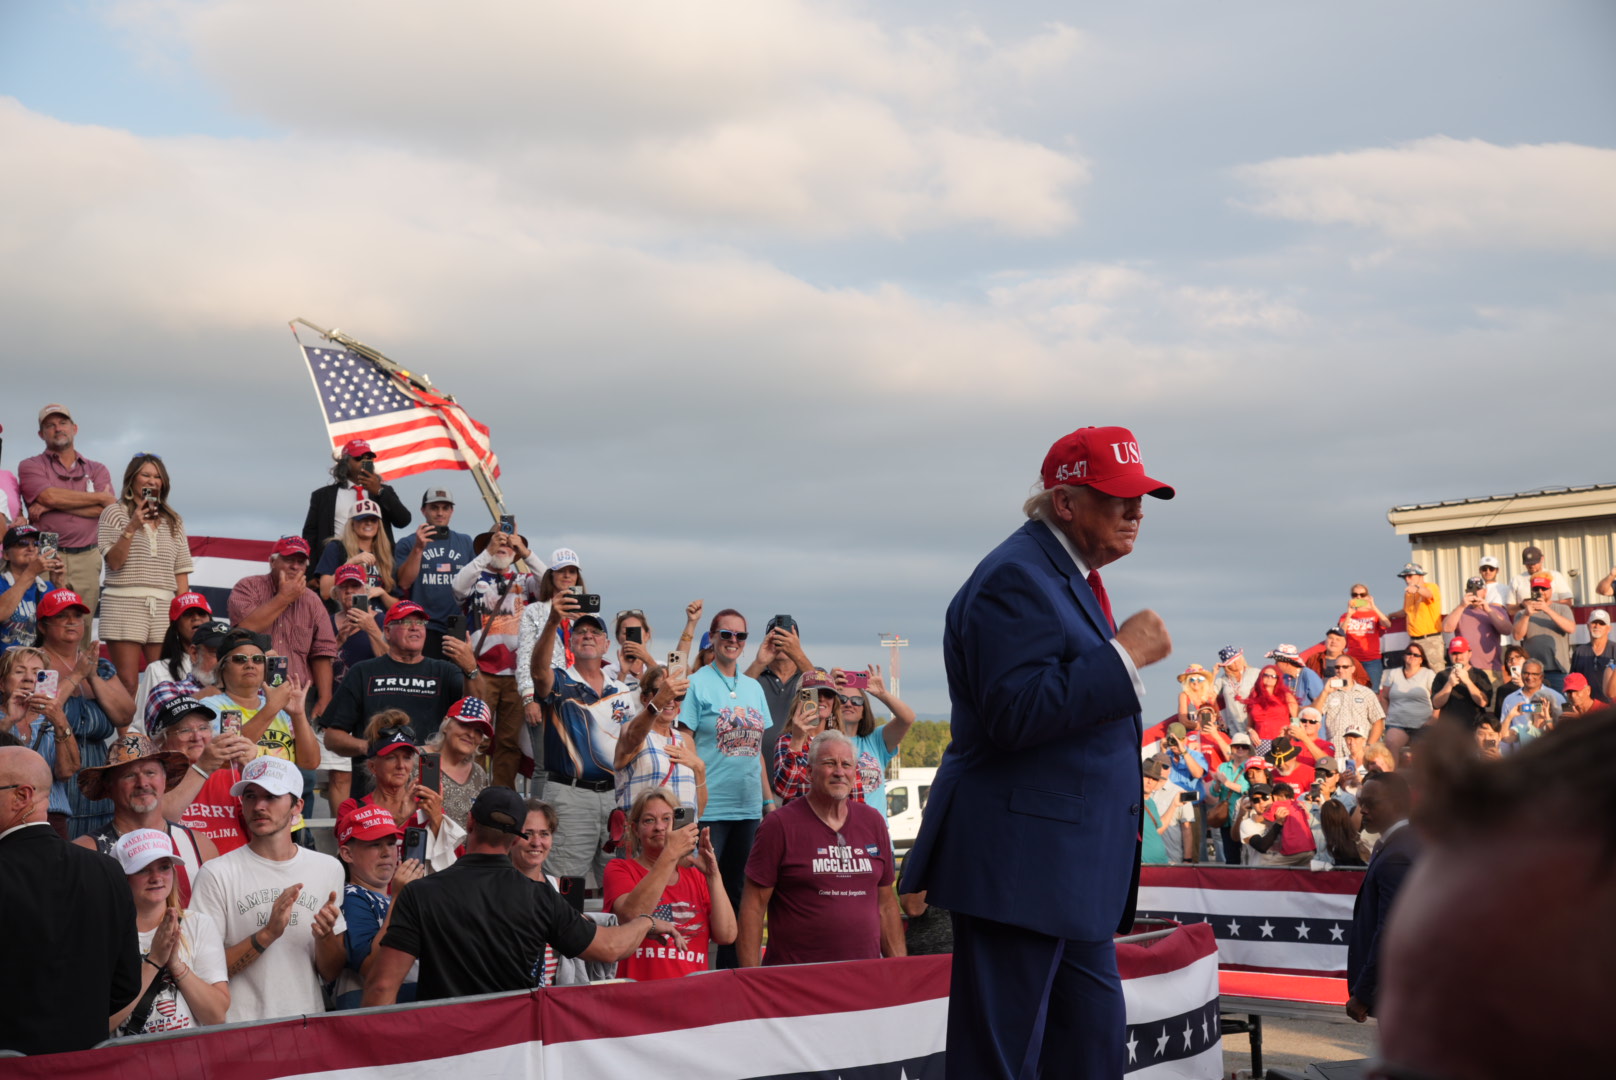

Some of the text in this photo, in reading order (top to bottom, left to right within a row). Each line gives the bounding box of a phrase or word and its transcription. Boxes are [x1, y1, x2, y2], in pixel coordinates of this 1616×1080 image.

[1056, 460, 1087, 481] 45-47
[356, 500, 379, 513] USA
[422, 547, 461, 561] GULF OF
[557, 550, 577, 563] USA
[422, 573, 457, 585] AMERI
[375, 677, 436, 688] TRUMP
[165, 697, 181, 710] MAKE
[171, 703, 190, 716] GREAT
[262, 731, 294, 747] ANTA
[202, 828, 238, 839] OLINA
[122, 834, 143, 849] MAKE
[127, 842, 152, 858] GREAT
[828, 845, 853, 859] FORT
[812, 858, 873, 873] MCCLELLAN
[236, 888, 318, 915] AMERAN
[256, 912, 298, 927] ME
[636, 947, 705, 964] FREEDOM
